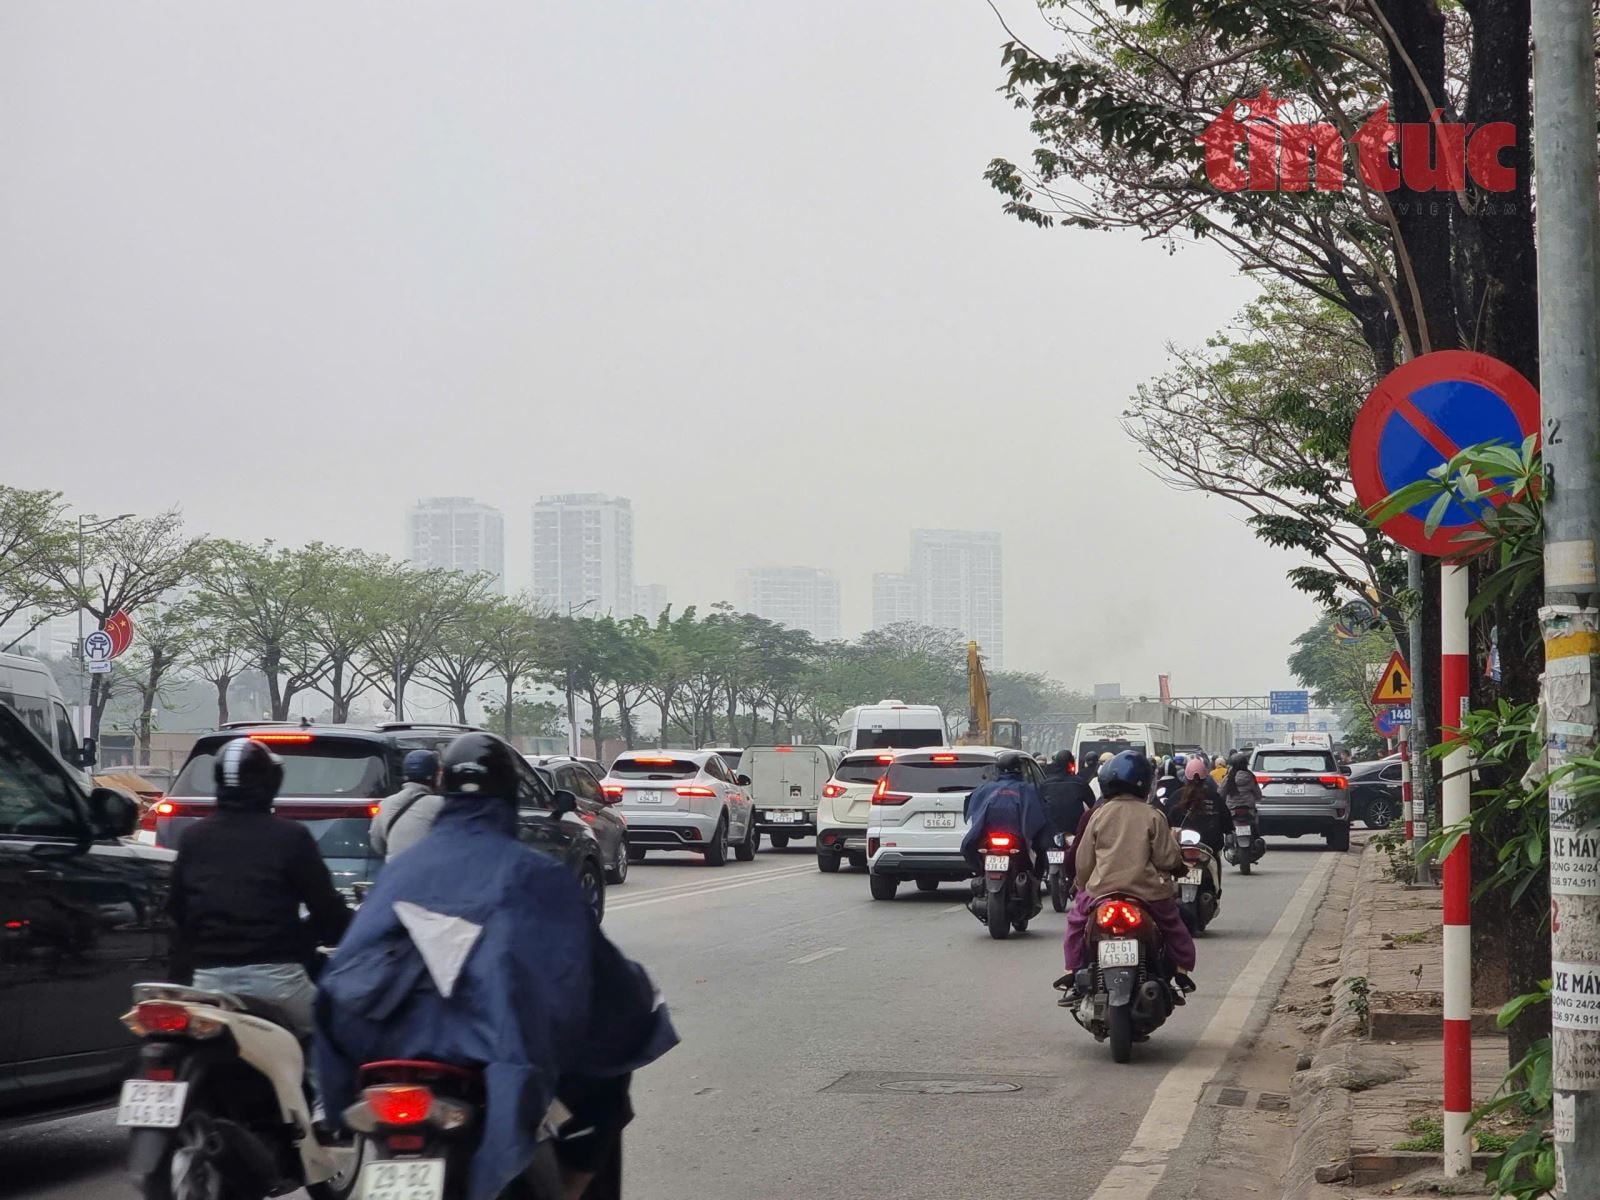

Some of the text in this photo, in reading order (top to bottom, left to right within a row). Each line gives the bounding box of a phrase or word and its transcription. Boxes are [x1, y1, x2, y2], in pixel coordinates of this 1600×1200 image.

[1390, 708, 1412, 720] 148
[1569, 834, 1598, 858] MÁY
[1573, 863, 1598, 873] 24/24
[1105, 941, 1132, 953] 29-G1
[1555, 971, 1568, 992] XE
[1575, 999, 1600, 1010] 24/24
